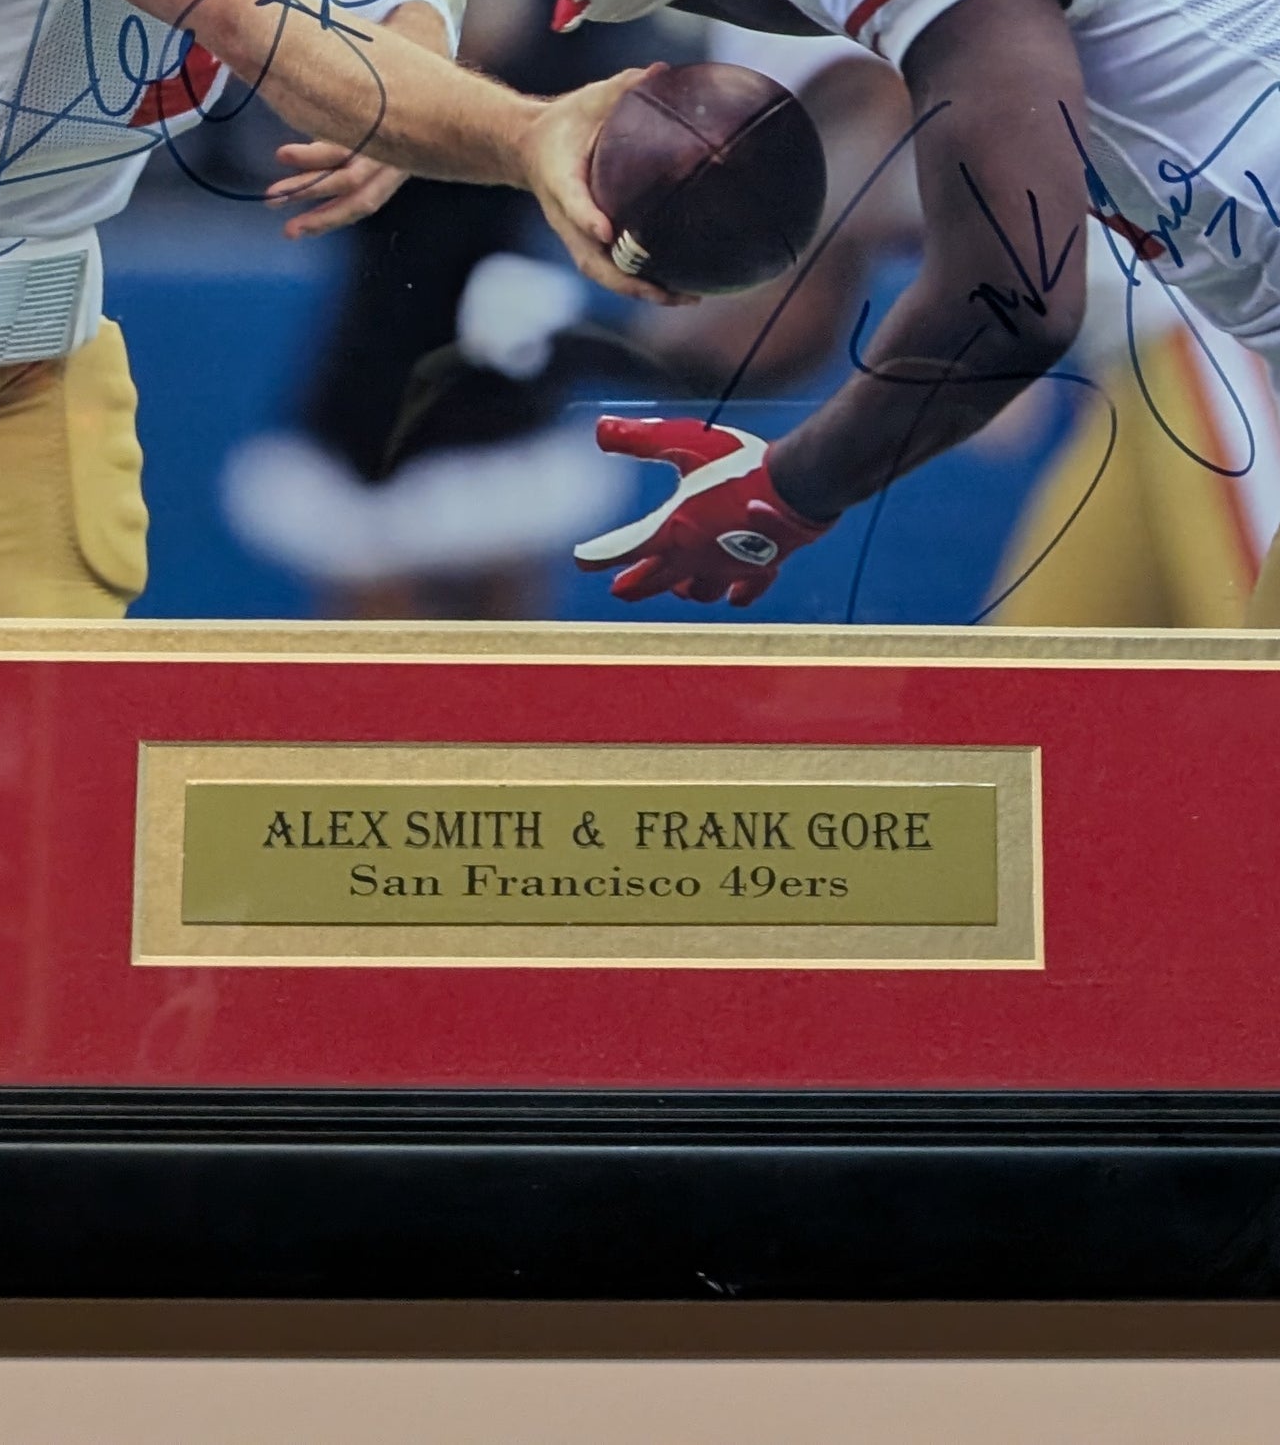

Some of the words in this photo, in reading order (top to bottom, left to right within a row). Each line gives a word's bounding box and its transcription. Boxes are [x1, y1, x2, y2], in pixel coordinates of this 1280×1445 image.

[263, 811, 391, 848] ALEX
[405, 811, 543, 848] SMITH
[573, 811, 606, 847] &
[635, 811, 795, 850] FRANK
[807, 811, 933, 850] GORE
[351, 864, 443, 896] San
[461, 865, 701, 897] Francisco
[720, 866, 849, 898] 49ers
